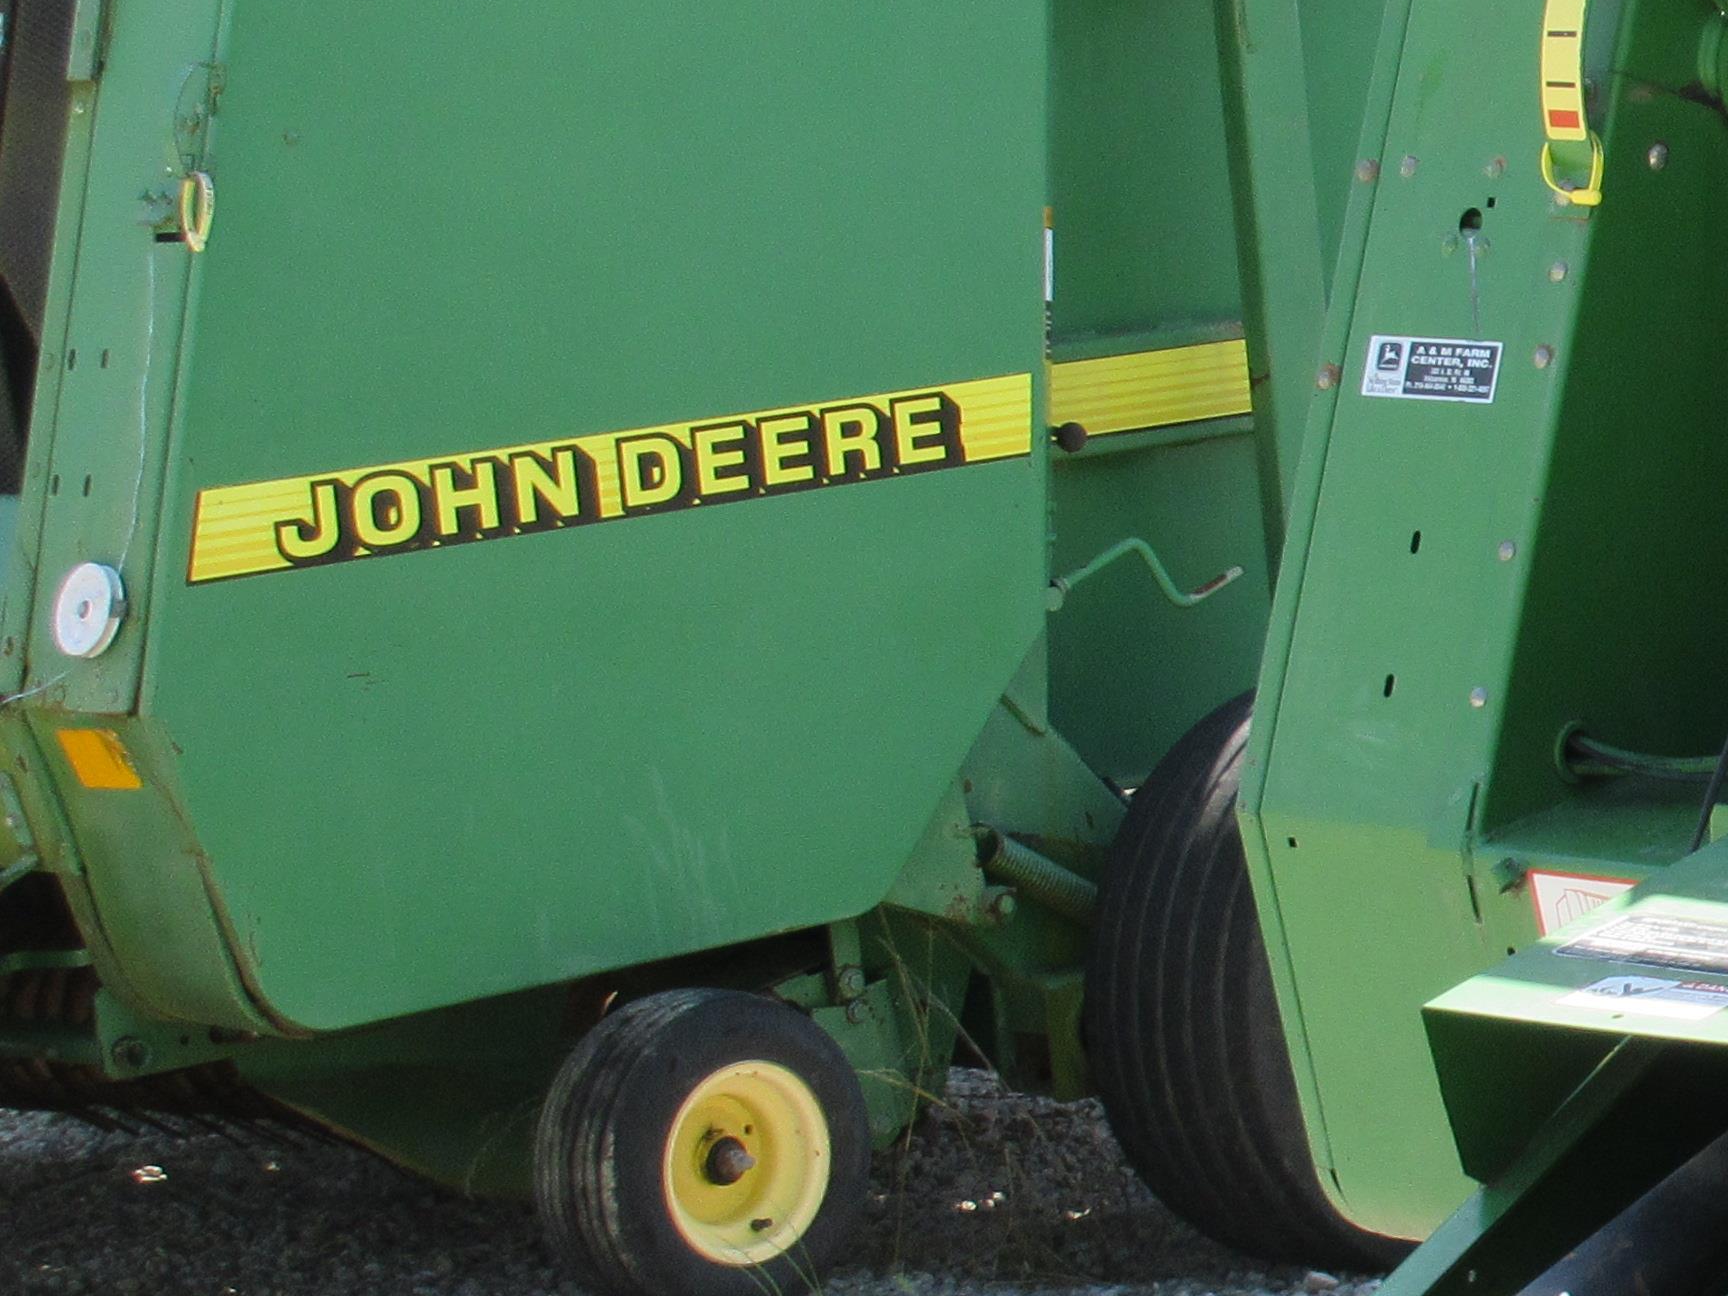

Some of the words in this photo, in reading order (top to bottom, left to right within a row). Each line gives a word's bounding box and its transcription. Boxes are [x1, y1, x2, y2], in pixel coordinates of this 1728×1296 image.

[1417, 346, 1425, 355] A
[1429, 346, 1437, 355] &
[1441, 347, 1452, 356] M
[1456, 348, 1491, 358] FARM
[1411, 356, 1463, 368] CENTER,
[1468, 359, 1492, 368] INC.
[274, 446, 597, 567] JOHN
[619, 391, 960, 510] DEERE
